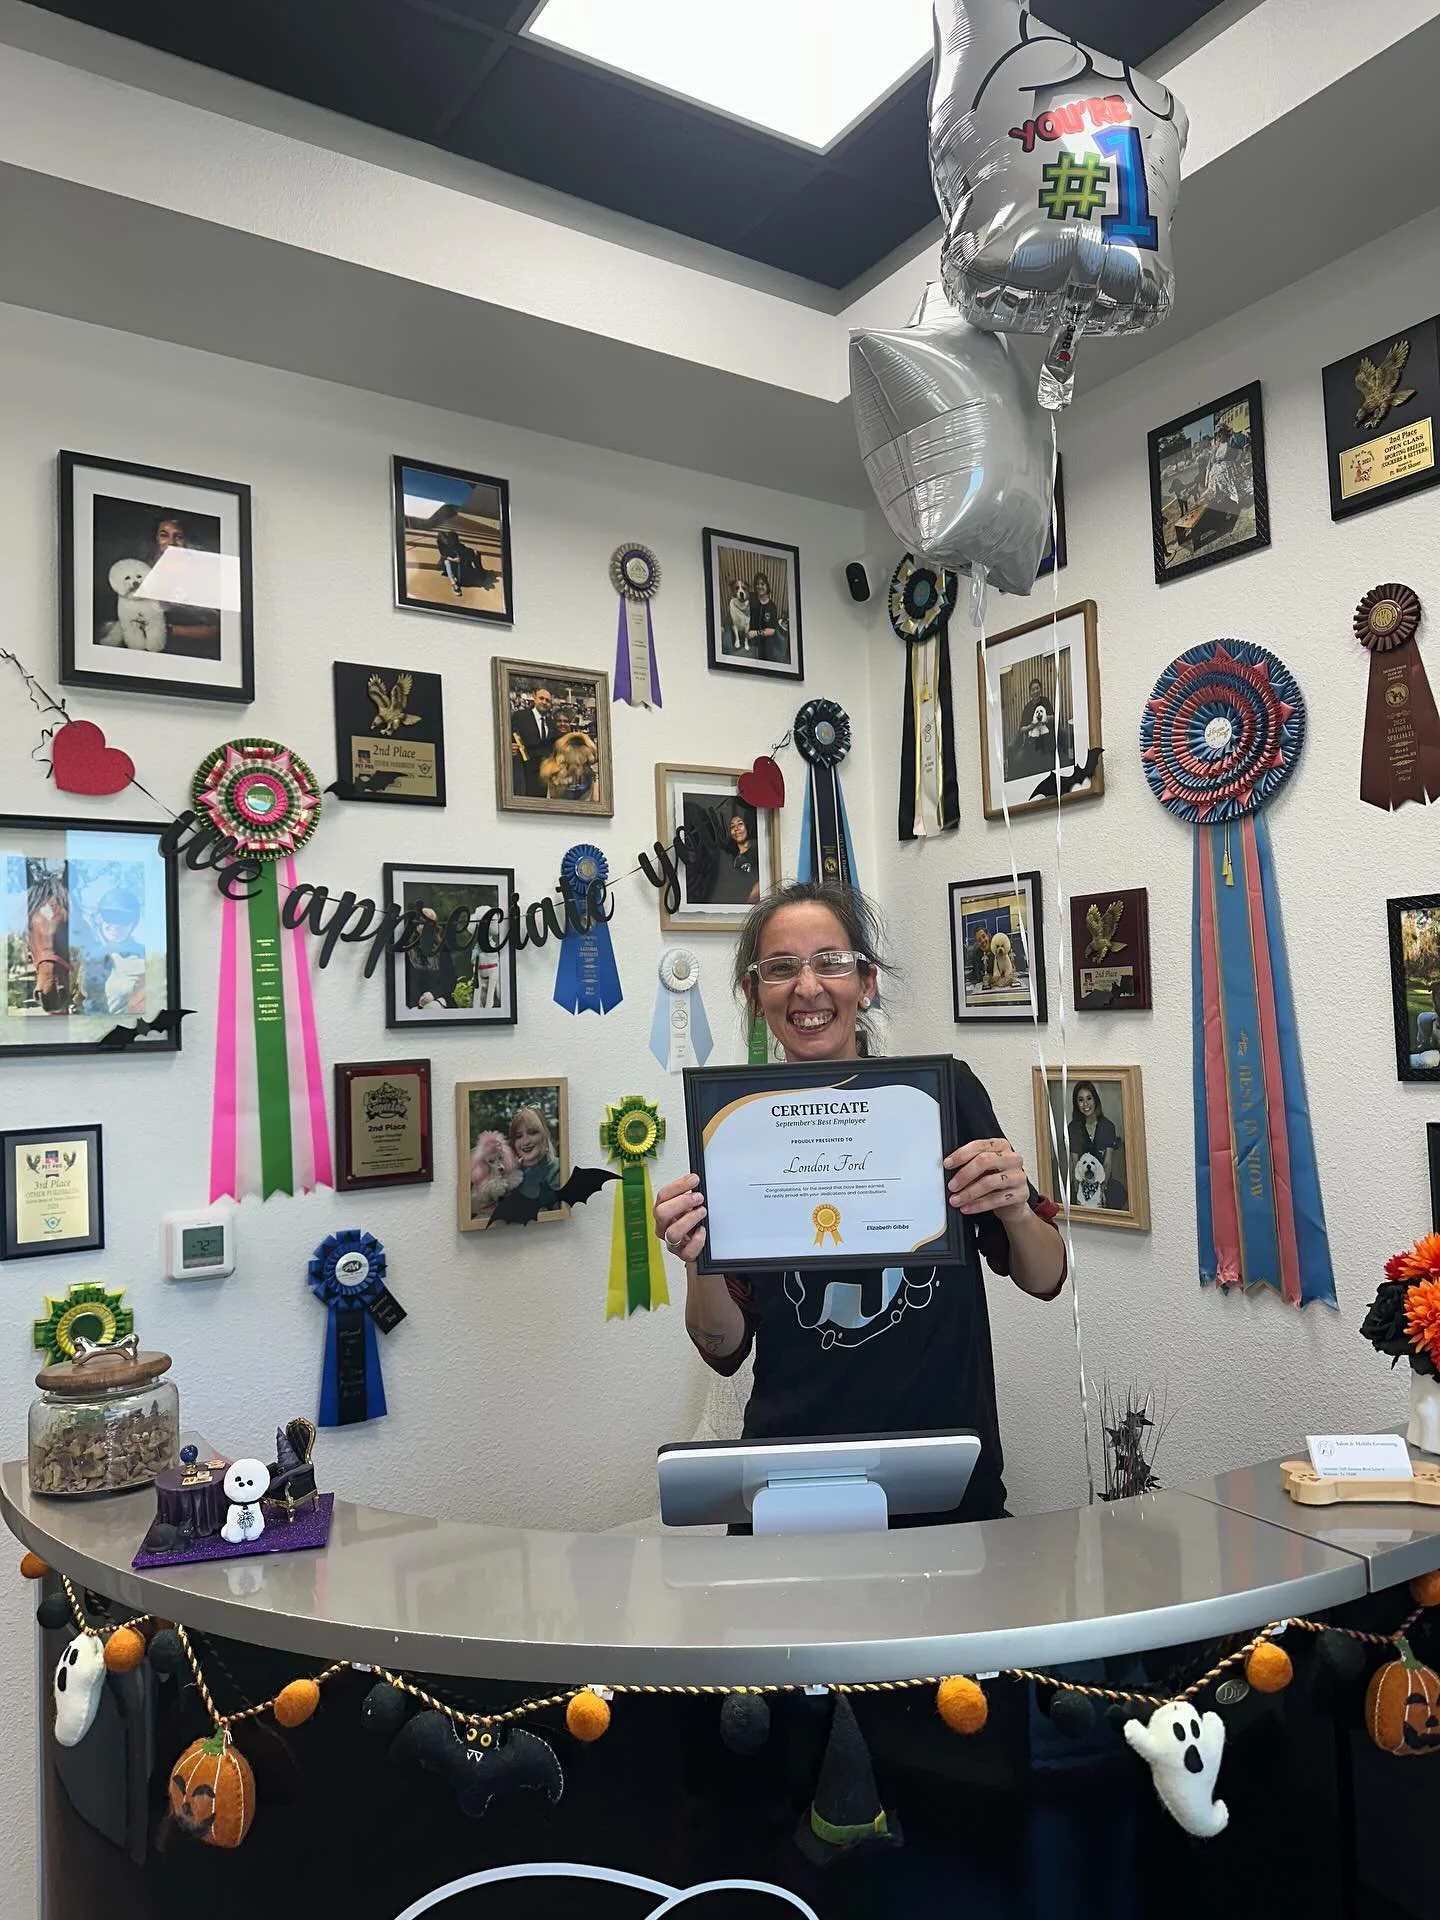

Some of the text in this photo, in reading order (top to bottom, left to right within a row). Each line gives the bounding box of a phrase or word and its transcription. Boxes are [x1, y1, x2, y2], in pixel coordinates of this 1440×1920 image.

[1008, 95, 1132, 153] YOU'RE
[1384, 434, 1424, 454] OPEN CLASS
[373, 744, 416, 759] 2nd Place
[158, 810, 263, 900] we
[282, 875, 614, 979] appreciate
[771, 1101, 870, 1117] CERTIFICATE
[368, 1122, 407, 1133] 2nd Place
[775, 1117, 867, 1129] September's Best Employee
[783, 1150, 873, 1174] London Ford
[33, 1181, 48, 1190] 3rd
